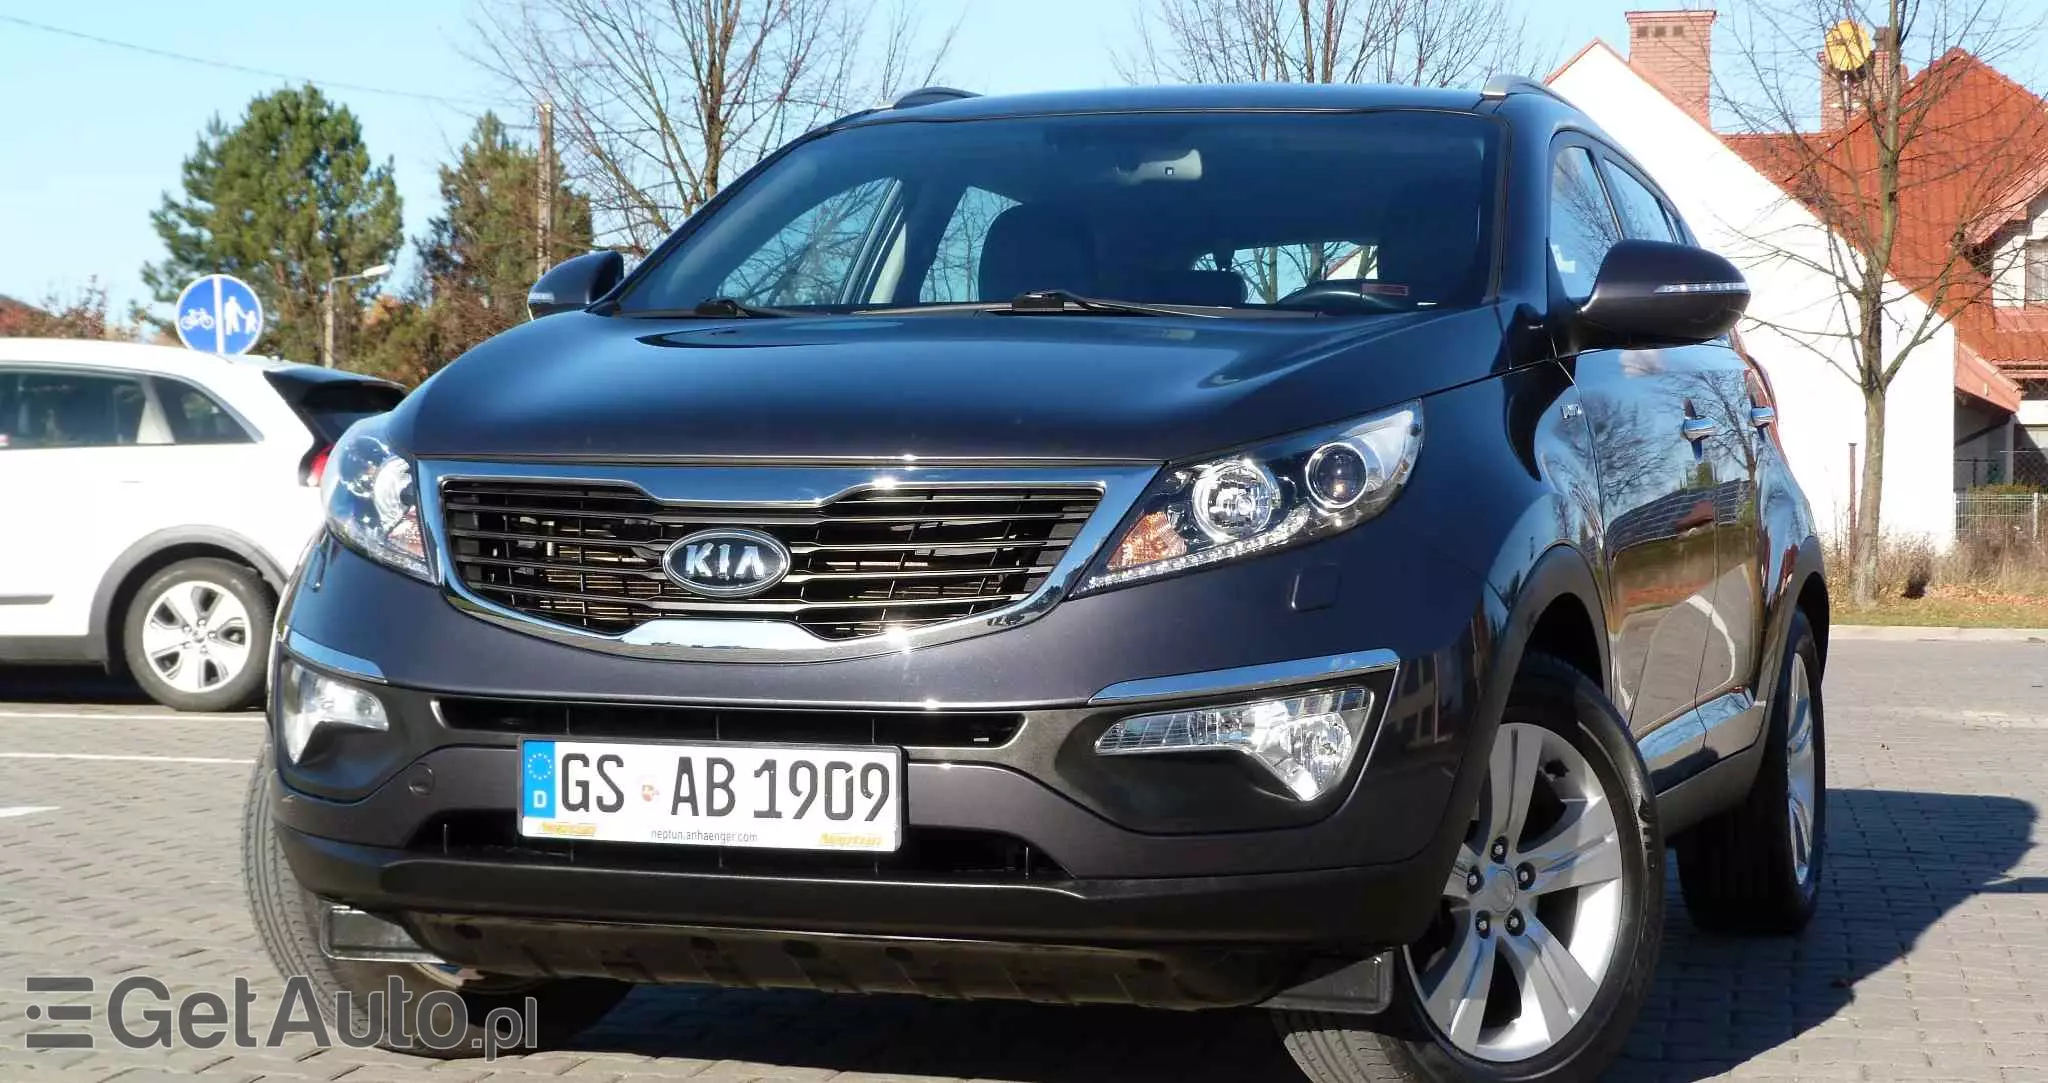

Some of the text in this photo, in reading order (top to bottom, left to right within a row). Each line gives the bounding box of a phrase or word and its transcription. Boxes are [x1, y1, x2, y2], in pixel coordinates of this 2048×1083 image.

[685, 543, 765, 579] KIA
[533, 790, 547, 809] D
[561, 753, 890, 822] GS AB 1909
[651, 829, 758, 844] neptun.anhaenger.com
